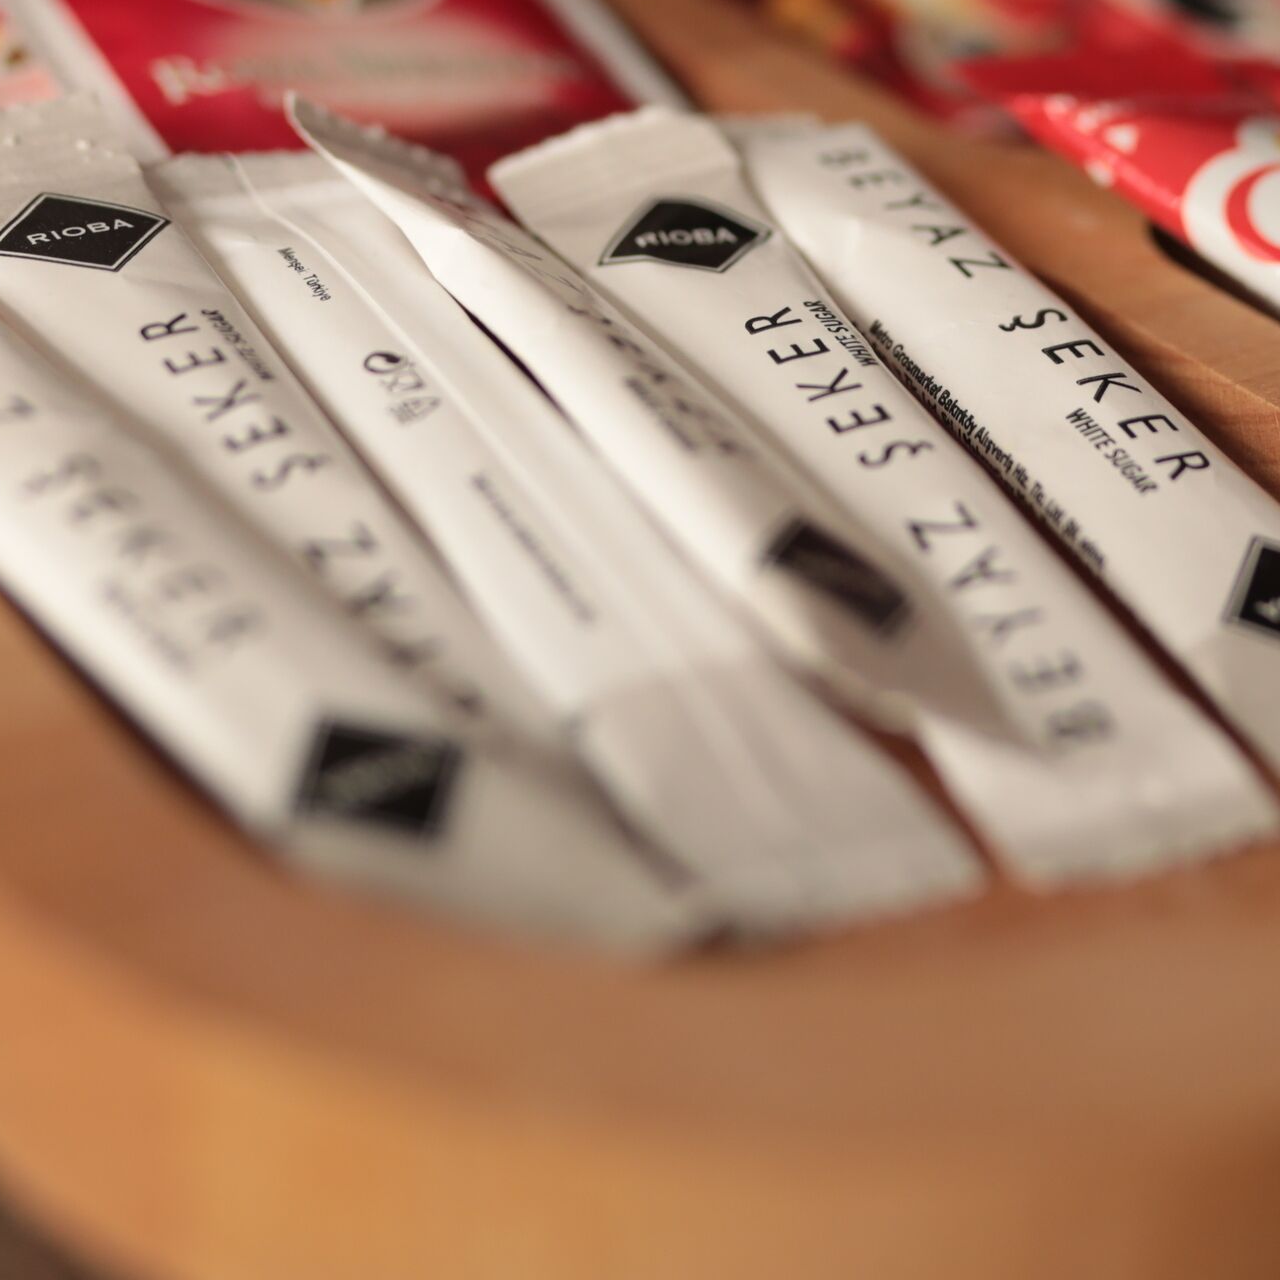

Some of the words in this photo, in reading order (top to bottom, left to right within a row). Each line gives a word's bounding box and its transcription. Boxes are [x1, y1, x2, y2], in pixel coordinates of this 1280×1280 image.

[26, 216, 135, 246] RIOBA
[632, 224, 737, 249] RIOBA
[803, 300, 849, 333] SUGAR
[819, 147, 1012, 278] BEYAZ
[999, 308, 1210, 483] ŞEKER
[835, 334, 879, 367] WHITE
[892, 343, 943, 401] Grosmarket
[140, 310, 332, 495] ŞEKER
[744, 305, 934, 468] ŞEKER
[1065, 407, 1116, 451] WHITE
[1103, 446, 1158, 496] SUGAR
